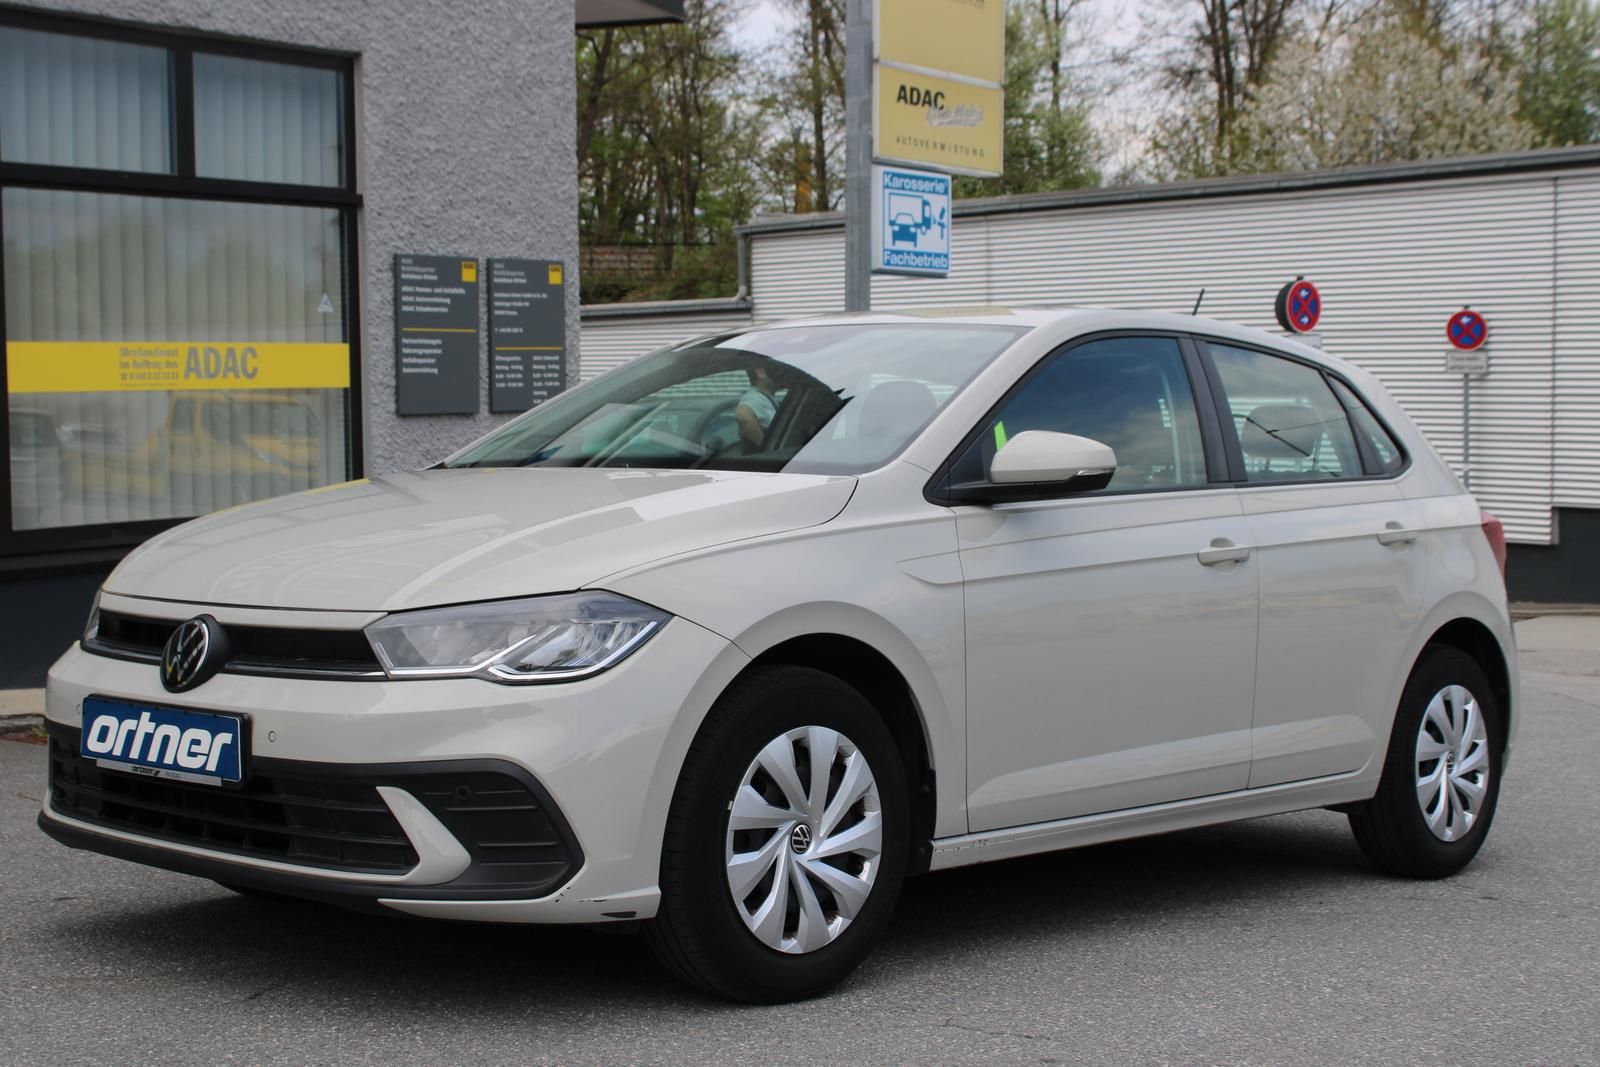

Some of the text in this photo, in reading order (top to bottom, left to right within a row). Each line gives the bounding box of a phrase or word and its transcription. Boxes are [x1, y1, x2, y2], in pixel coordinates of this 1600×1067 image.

[896, 84, 946, 111] ADAC
[896, 135, 985, 158] AUTOVERMIETUNG
[884, 173, 946, 193] Karosserie
[884, 250, 948, 268] Fachbetrieb
[183, 346, 258, 380] ADAC
[86, 711, 233, 772] ortner
